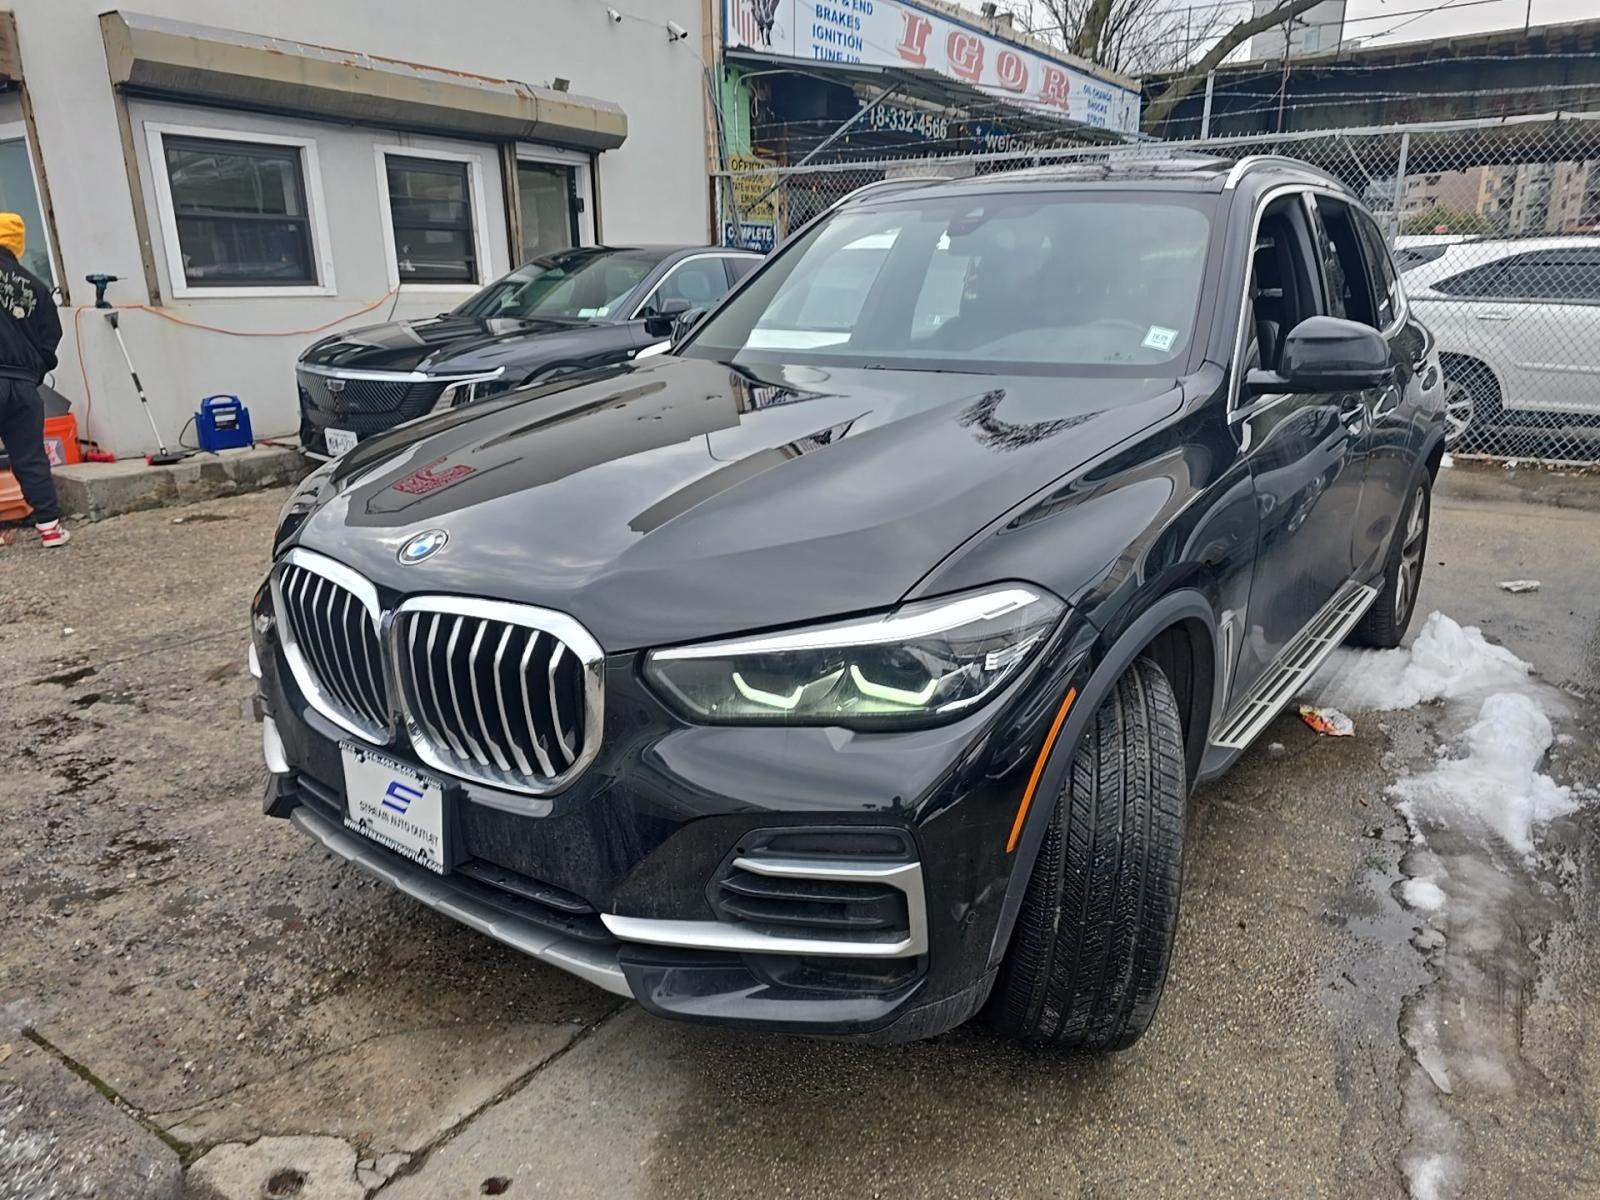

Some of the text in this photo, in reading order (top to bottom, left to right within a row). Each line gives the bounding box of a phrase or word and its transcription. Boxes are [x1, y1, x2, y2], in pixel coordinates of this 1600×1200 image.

[815, 4, 861, 31] BRAKES
[812, 23, 863, 51] IGNITION
[896, 9, 1070, 110] IGOR
[731, 159, 768, 172] OFFICIA
[727, 226, 772, 241] CMPLETE
